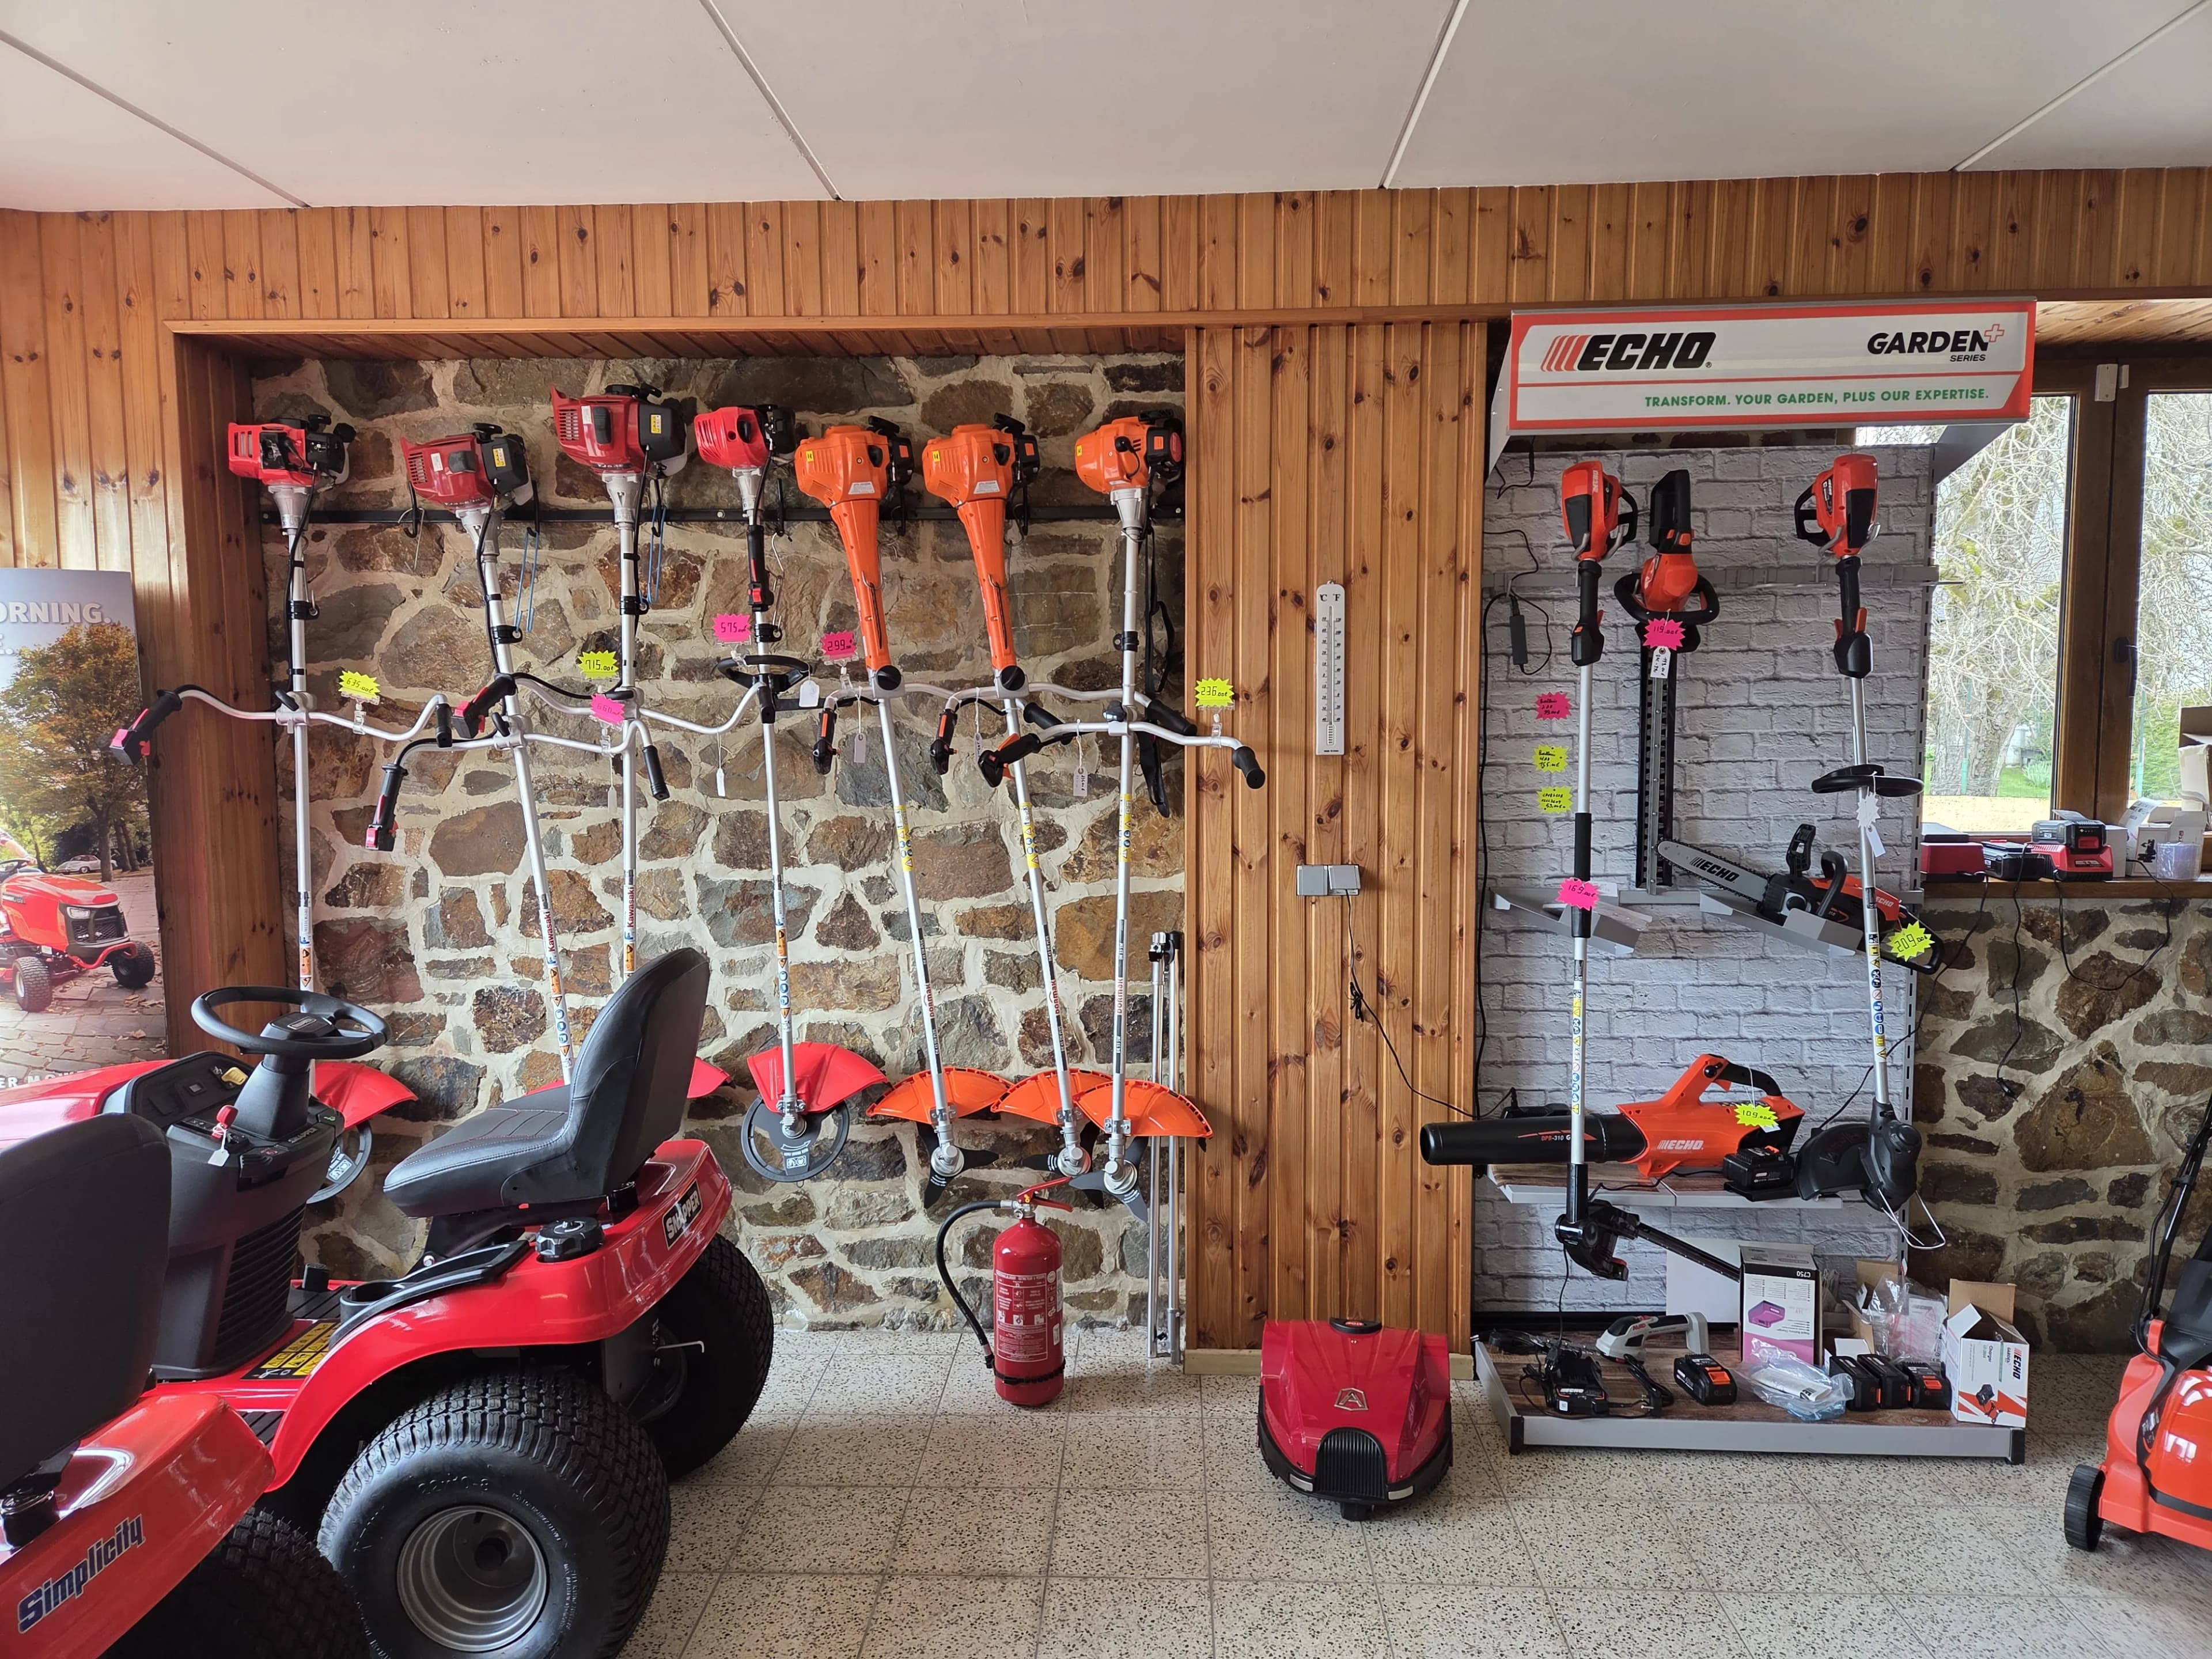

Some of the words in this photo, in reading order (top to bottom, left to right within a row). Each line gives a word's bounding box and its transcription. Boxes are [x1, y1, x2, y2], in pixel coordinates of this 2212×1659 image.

[1577, 332, 1717, 370] ECHO
[1868, 330, 1990, 355] GARDEN
[1949, 354, 1986, 363] SERIES
[1645, 395, 1730, 408] TRANSFORM.
[1735, 394, 1772, 406] YOUR
[1777, 392, 1838, 406] GARDEN,
[1843, 391, 1876, 403] PLUS
[1880, 389, 1910, 402] OUR
[1915, 388, 1989, 402] EXPERTISE.
[1700, 859, 1740, 882] ECHO
[627, 887, 635, 928] Kawasaki
[544, 911, 555, 952] Kawasaki
[1669, 1140, 1703, 1150] ECHO
[666, 1190, 700, 1239] SNAPPER
[2013, 1354, 2021, 1380] ECHO
[18, 1514, 146, 1634] Simplicity
